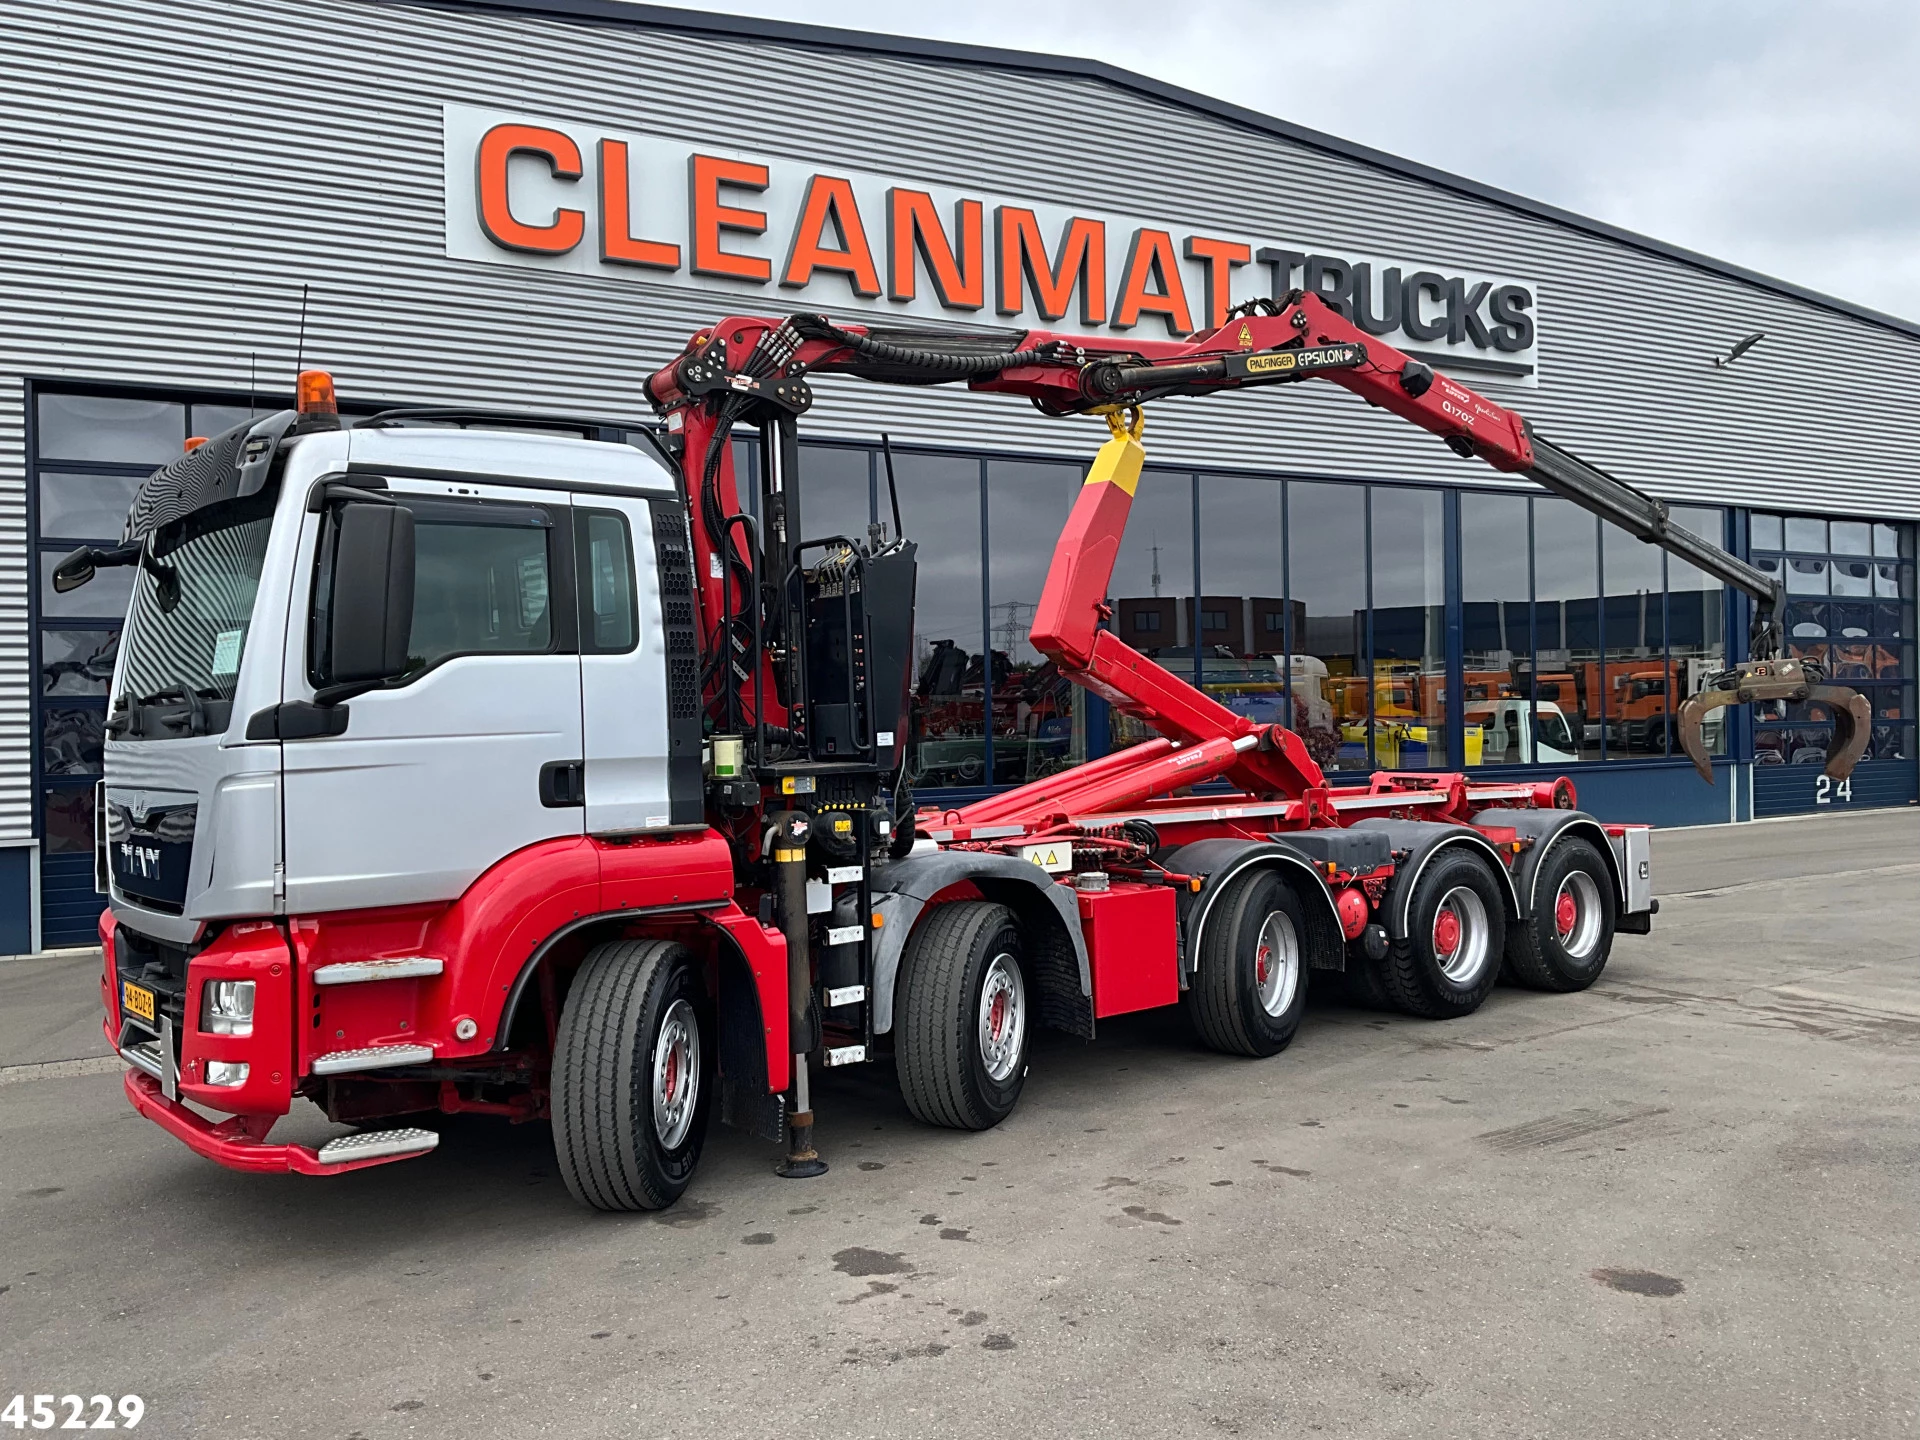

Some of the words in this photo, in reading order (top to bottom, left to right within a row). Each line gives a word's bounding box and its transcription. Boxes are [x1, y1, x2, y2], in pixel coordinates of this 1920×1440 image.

[475, 122, 1250, 337] CLEANMAT
[1256, 246, 1534, 352] TRUCKS
[1250, 356, 1293, 370] PALFINGER
[1297, 349, 1343, 367] EPSILON
[1442, 400, 1475, 426] Q170Z
[1816, 774, 1852, 804] 24
[121, 843, 160, 880] MAN
[125, 985, 152, 1016] 94-BDZ-8
